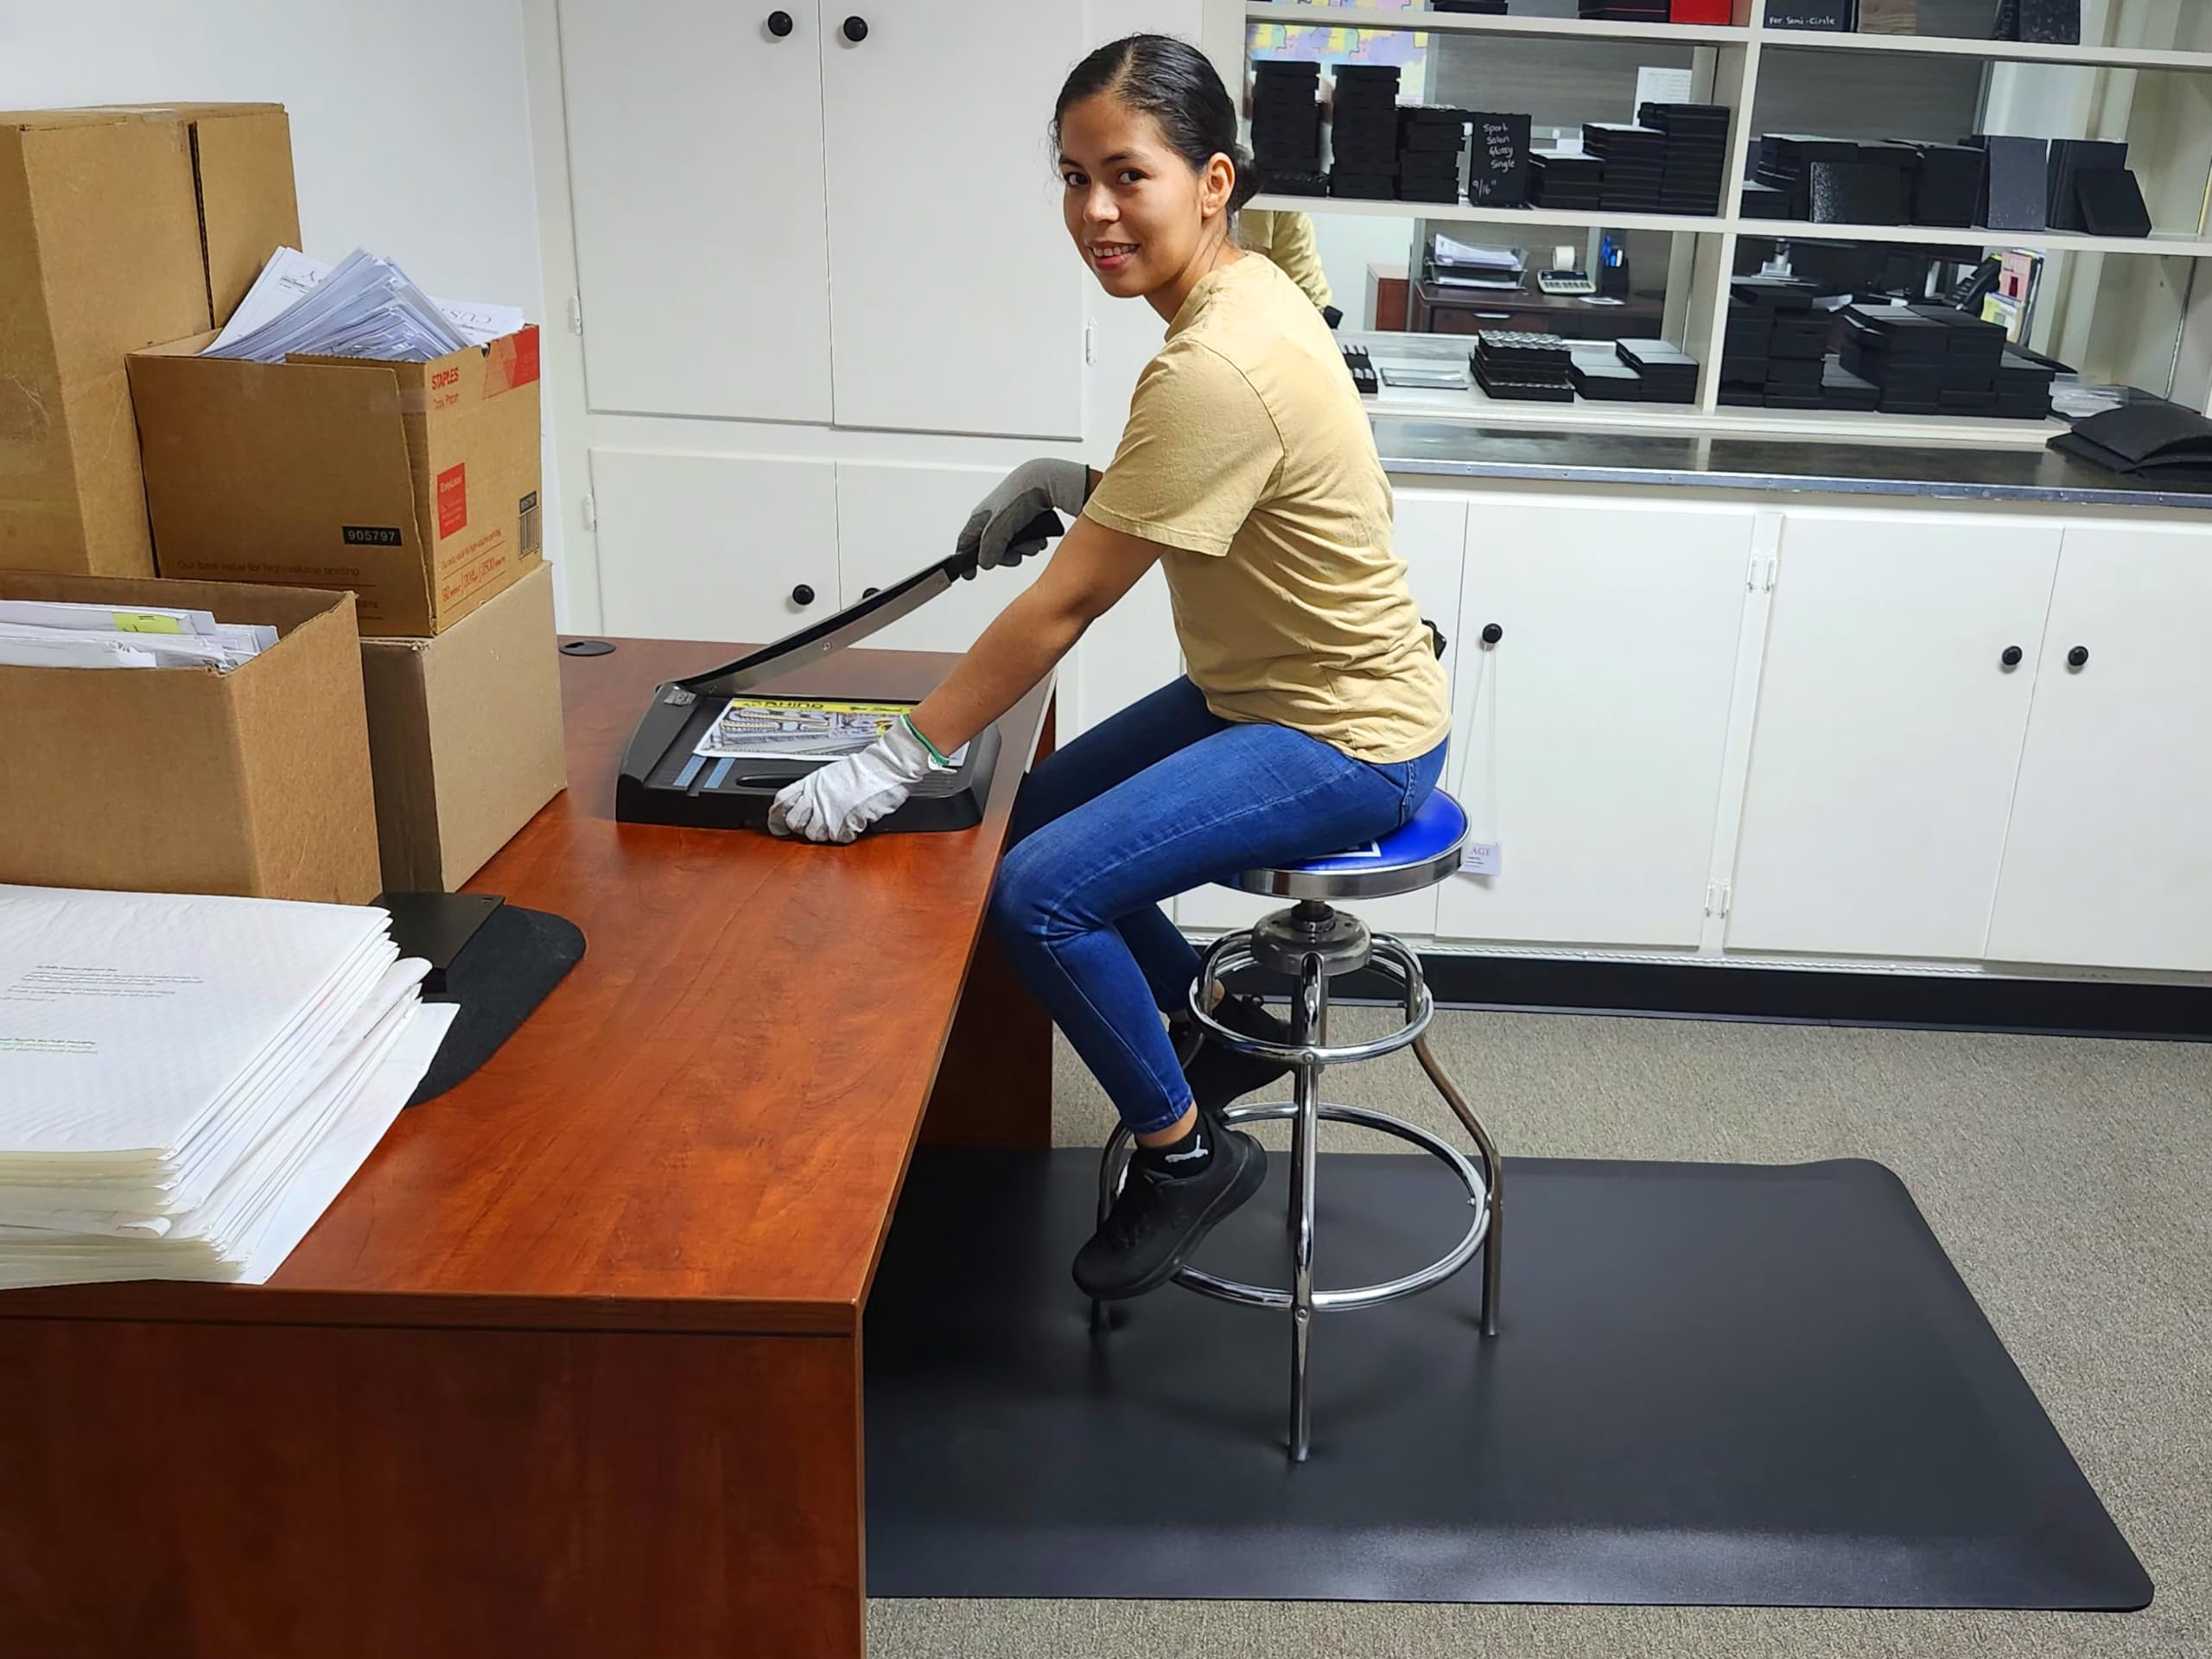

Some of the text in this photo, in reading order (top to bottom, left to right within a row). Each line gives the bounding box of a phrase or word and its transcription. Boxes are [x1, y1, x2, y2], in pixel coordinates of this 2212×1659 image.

[1491, 159, 1515, 173] Single
[431, 366, 459, 391] STAPLES
[347, 530, 396, 541] 905797
